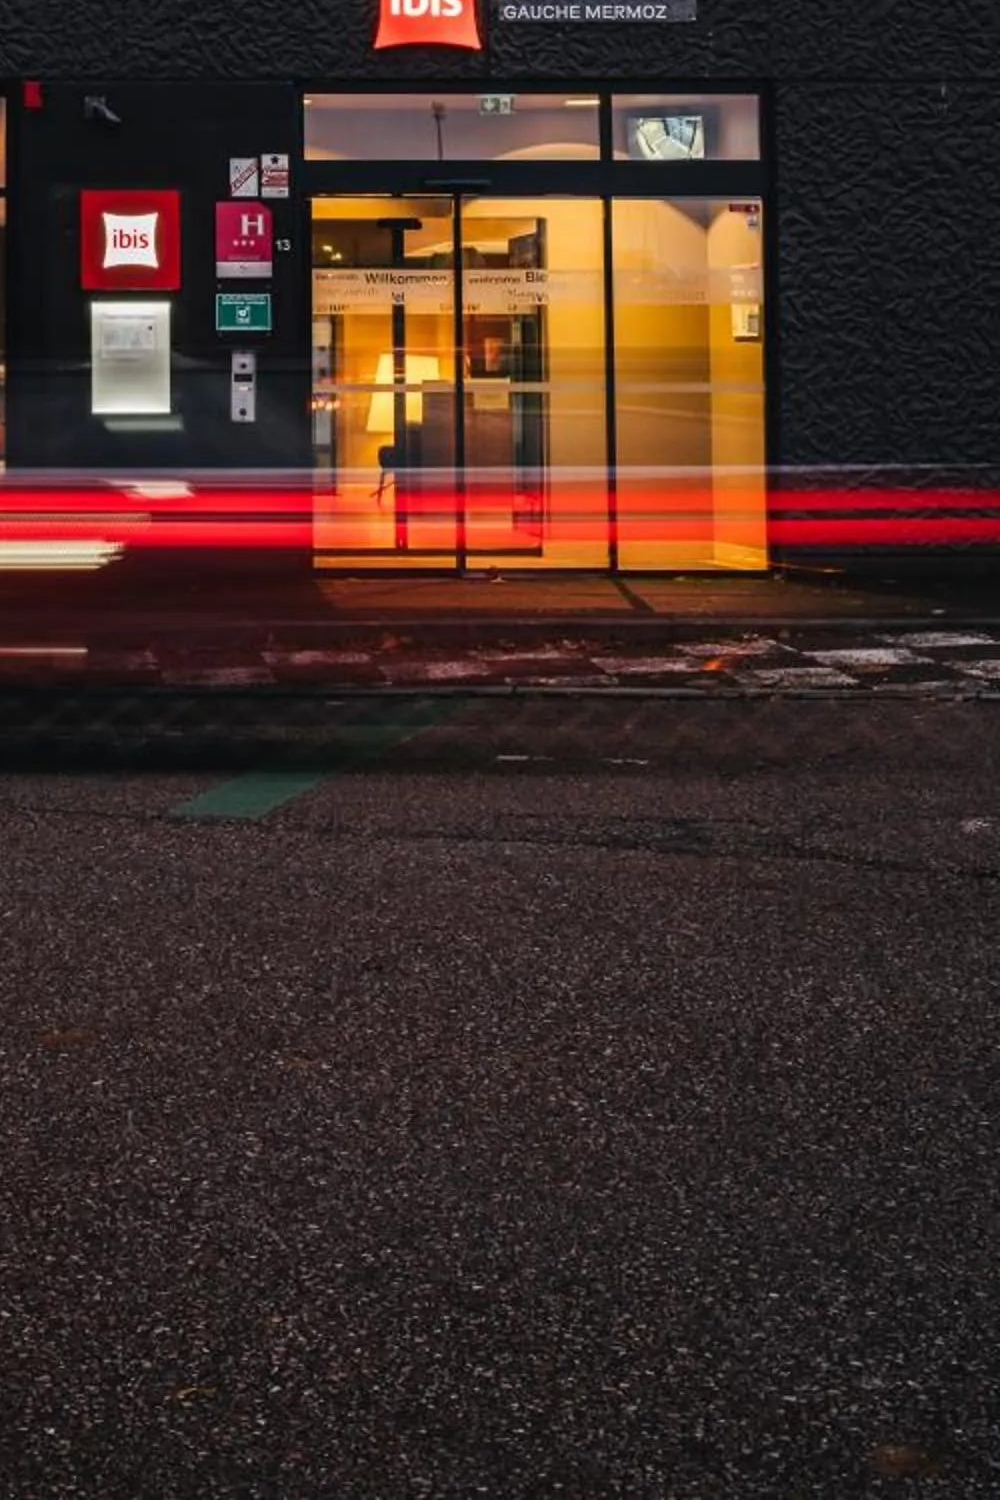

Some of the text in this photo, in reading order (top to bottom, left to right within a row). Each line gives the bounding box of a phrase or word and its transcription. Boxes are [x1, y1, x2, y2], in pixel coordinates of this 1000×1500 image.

[503, 4, 667, 20] GAUCHE MERMOZ
[241, 213, 264, 236] H
[112, 228, 149, 249] ibis
[275, 239, 291, 251] 13
